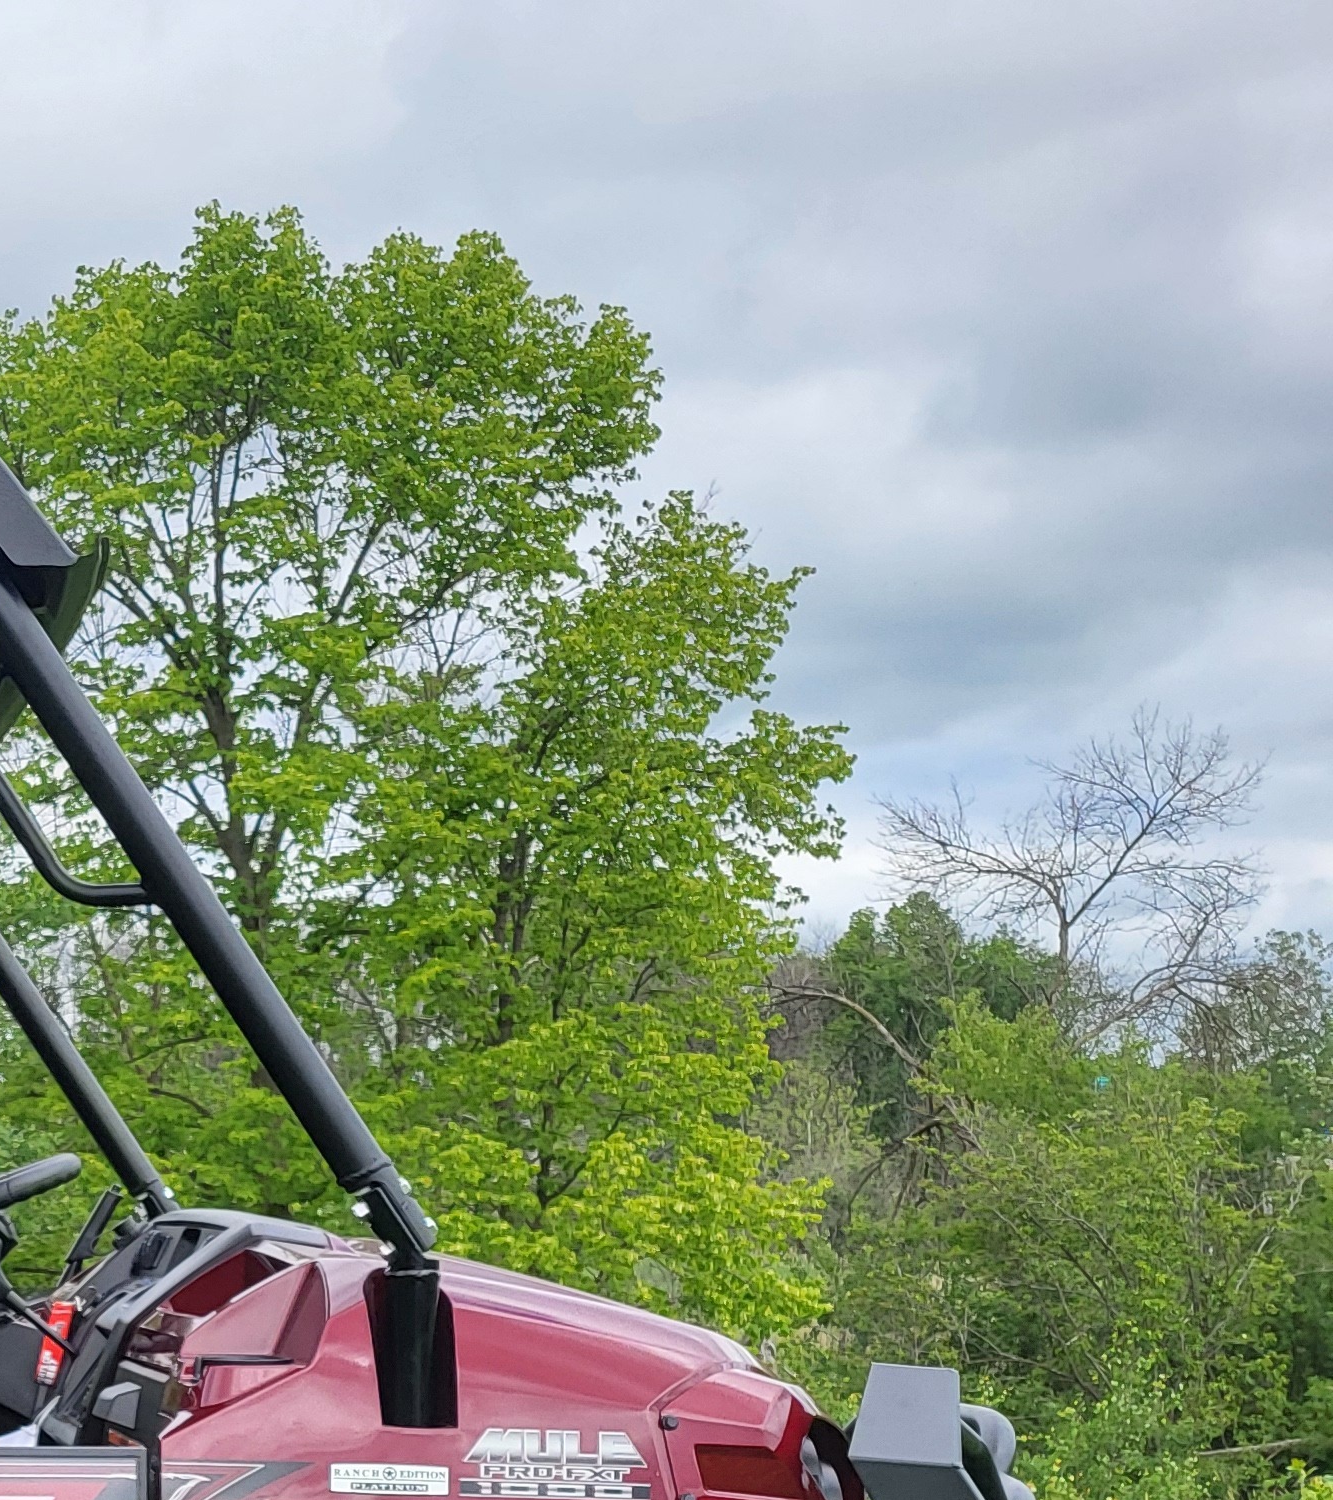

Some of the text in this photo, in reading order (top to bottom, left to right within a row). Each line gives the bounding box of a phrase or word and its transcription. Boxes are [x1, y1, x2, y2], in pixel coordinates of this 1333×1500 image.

[462, 1428, 648, 1468] MULE
[334, 1468, 446, 1479] RANCH EDITION
[480, 1464, 631, 1482] PRO-FXT
[351, 1482, 428, 1492] PLATINUM
[477, 1482, 633, 1498] 1000
